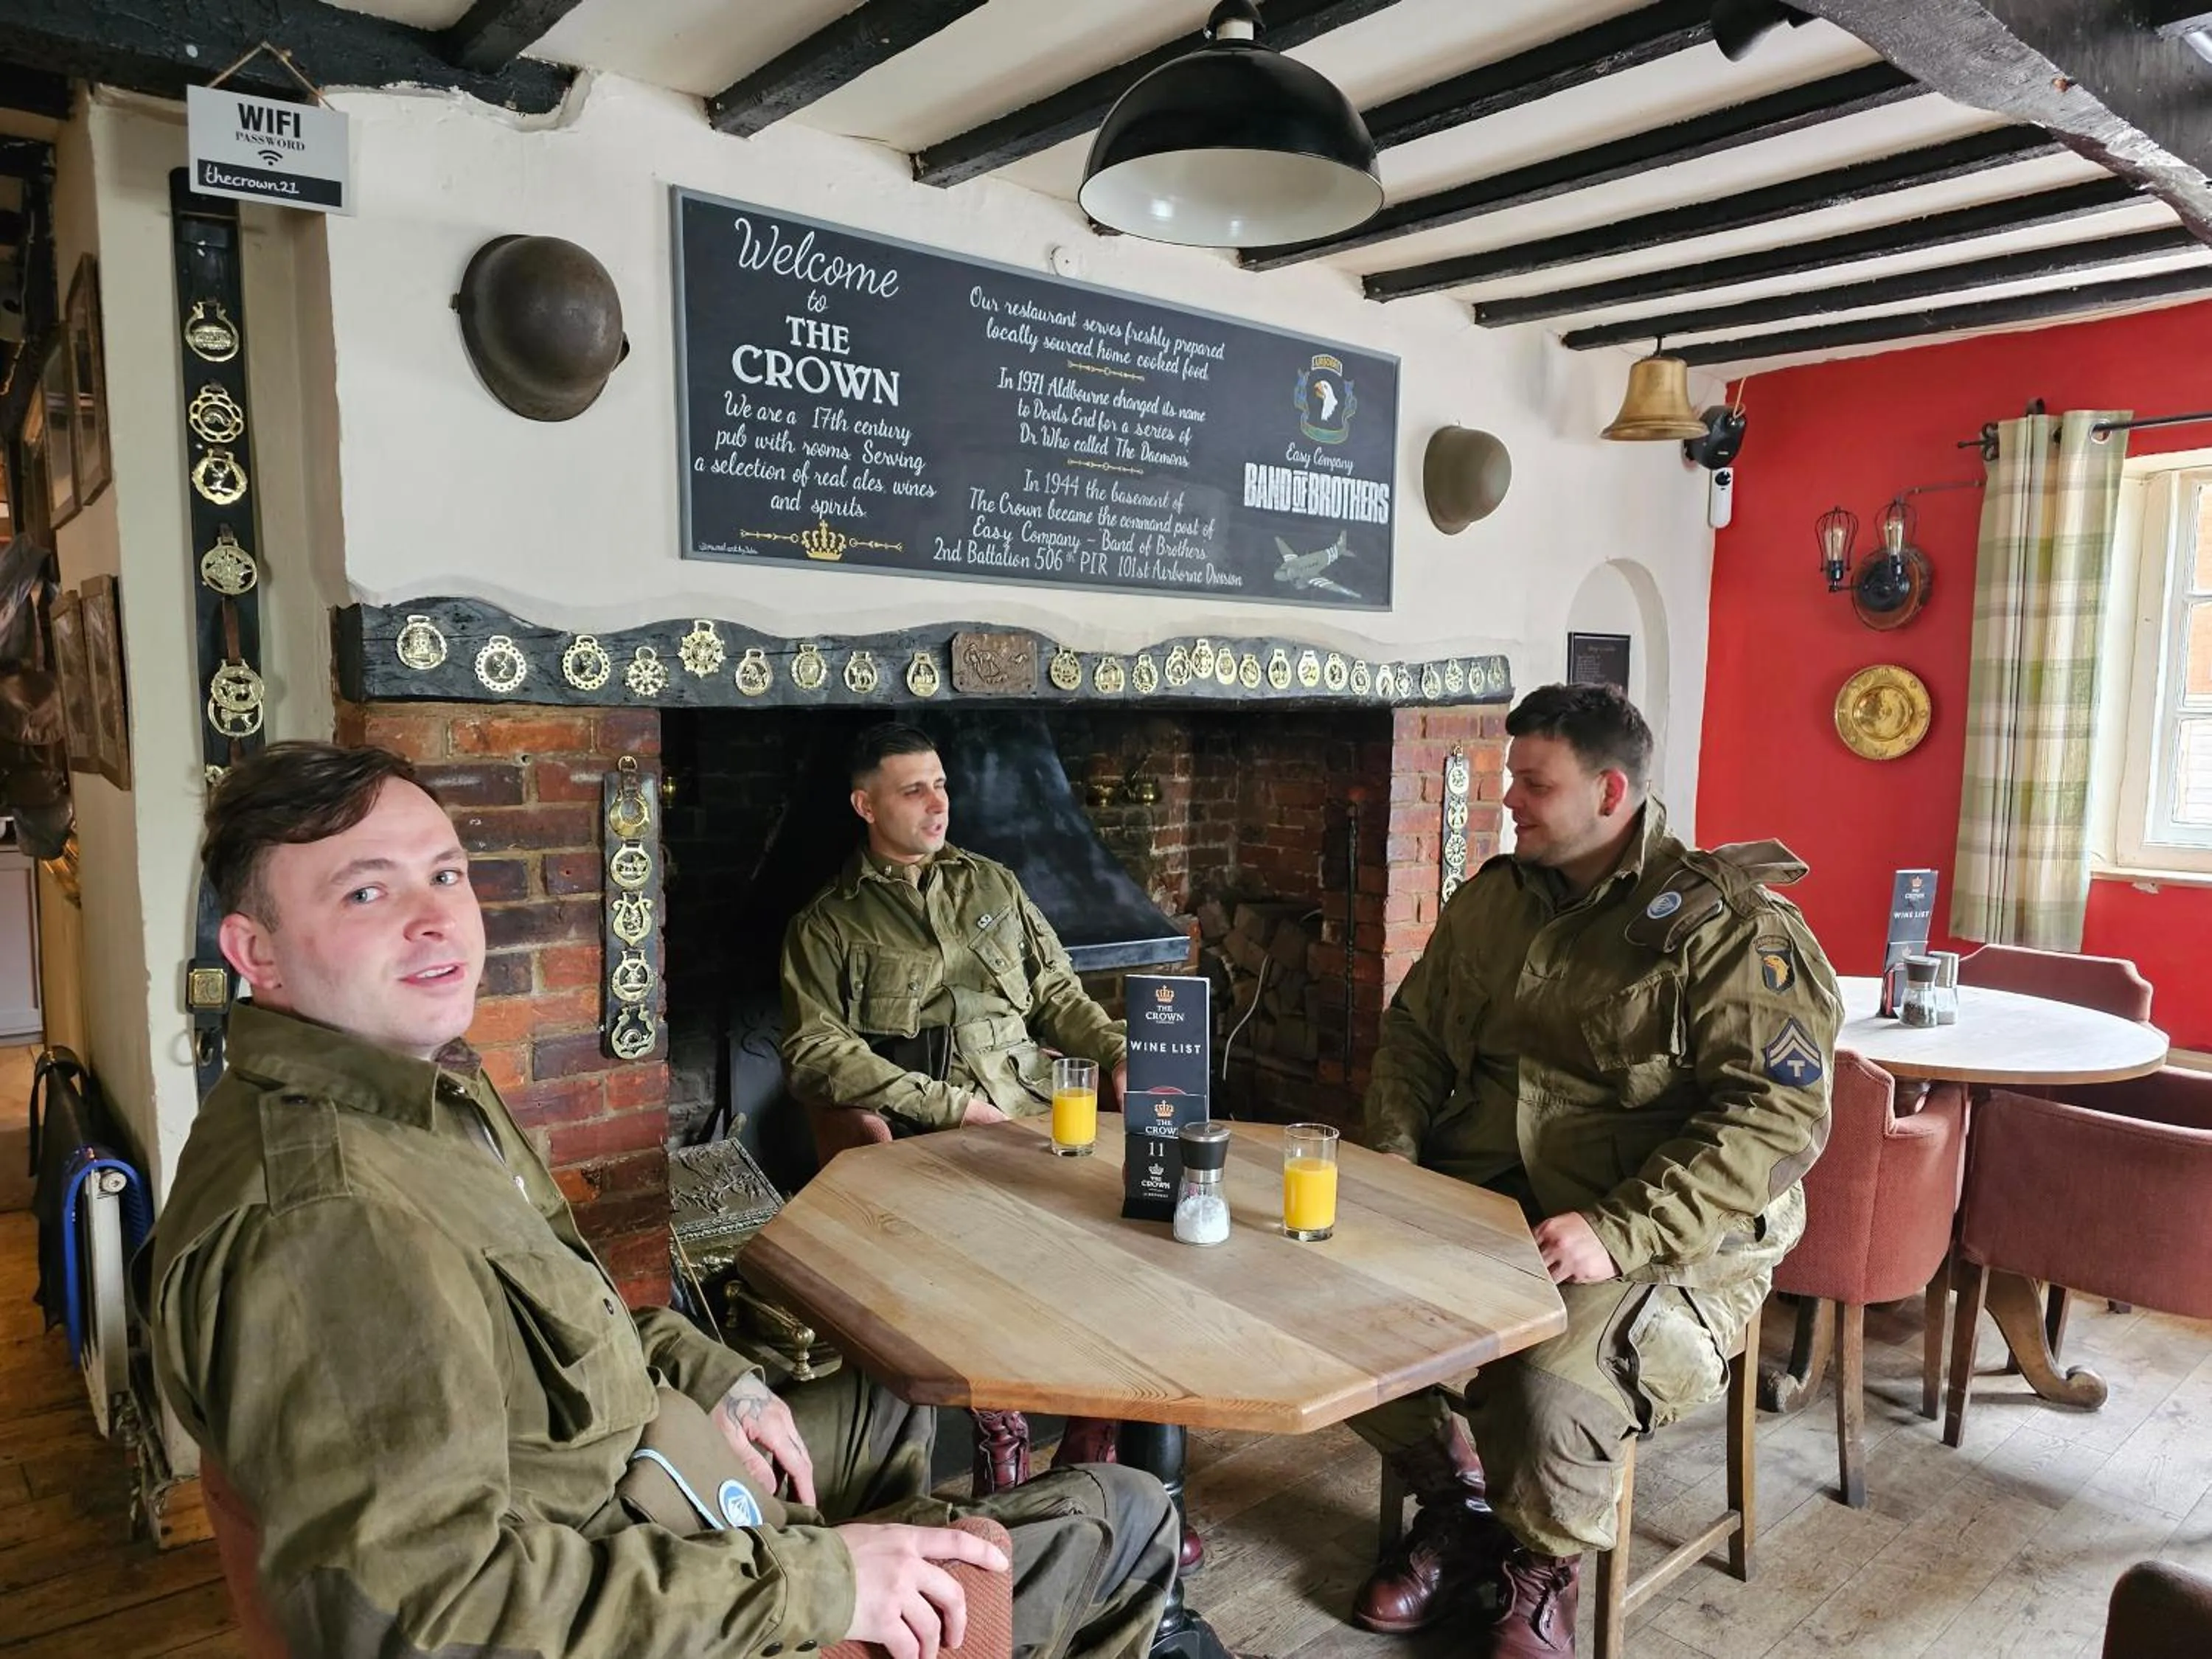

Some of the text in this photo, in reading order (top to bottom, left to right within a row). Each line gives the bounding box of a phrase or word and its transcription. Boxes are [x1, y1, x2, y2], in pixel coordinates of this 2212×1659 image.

[235, 131, 306, 151] PASSWORD
[237, 102, 300, 138] WIFI
[204, 164, 300, 194] thecrown21
[734, 218, 899, 298] Welcome
[807, 289, 829, 313] to
[970, 285, 1225, 360] Our restaurant serves freshly prepared
[785, 316, 850, 355] THE
[986, 316, 1038, 353] locally
[1043, 336, 1093, 358] sourced
[1096, 338, 1132, 364] home
[1136, 351, 1180, 374] cooked
[731, 344, 900, 406] CROWN
[997, 366, 1206, 422] In 1971 Aldbourne changed its name
[724, 390, 912, 446] We are a 17th century
[1018, 397, 1192, 446] to Devils End for a series of
[1020, 422, 1038, 446] Dr
[1040, 425, 1070, 449] Who
[1074, 434, 1110, 455] called
[714, 422, 747, 451] pub
[754, 428, 796, 453] with
[862, 439, 927, 476] Serving
[1286, 442, 1354, 476] Easy Company
[694, 456, 706, 472] a
[711, 451, 787, 481] selection
[793, 459, 810, 487] of
[814, 465, 849, 488] real
[892, 480, 937, 498] wines
[1023, 468, 1185, 514] In 1944 the basement of
[1244, 462, 1390, 524] BAND OF BROTHERS
[771, 489, 801, 512] and
[970, 486, 1216, 540] The Crown became the command post of
[973, 514, 1014, 547] Easy
[1021, 520, 1081, 554] Company
[1139, 534, 1152, 557] of
[933, 536, 961, 562] 2nd
[967, 540, 1030, 568] Battalion
[1080, 551, 1108, 577] PIR
[1118, 555, 1150, 579] 101st
[1152, 559, 1203, 582] Airborne
[1206, 563, 1243, 586] Division
[1145, 1011, 1185, 1021] CROWN
[1130, 1040, 1201, 1054] WINE LIST
[1787, 1060, 1807, 1078] T
[1149, 1141, 1164, 1157] 11
